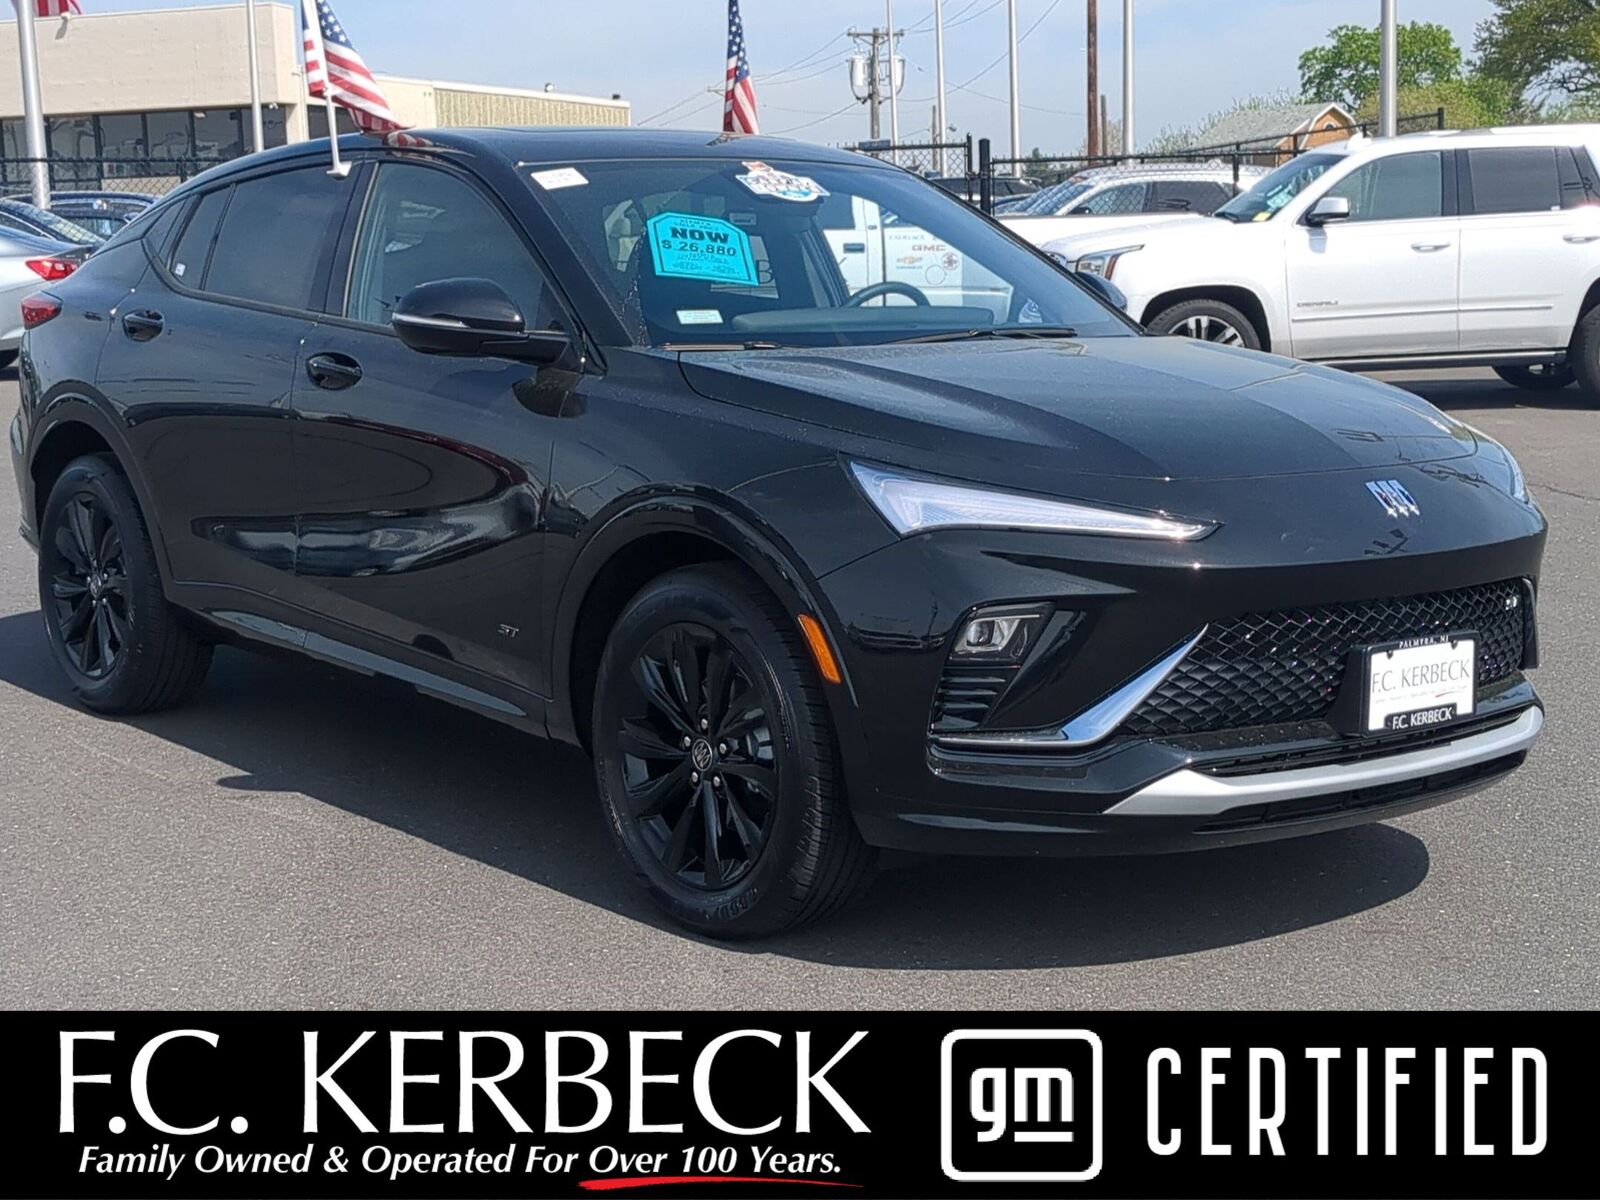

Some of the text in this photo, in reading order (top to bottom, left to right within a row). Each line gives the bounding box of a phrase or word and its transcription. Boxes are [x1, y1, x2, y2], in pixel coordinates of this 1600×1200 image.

[670, 226, 730, 244] NOW
[661, 239, 672, 250] $
[912, 244, 946, 252] GMC
[1372, 658, 1471, 693] F.C. KERBECK
[1410, 706, 1453, 727] KERBECK
